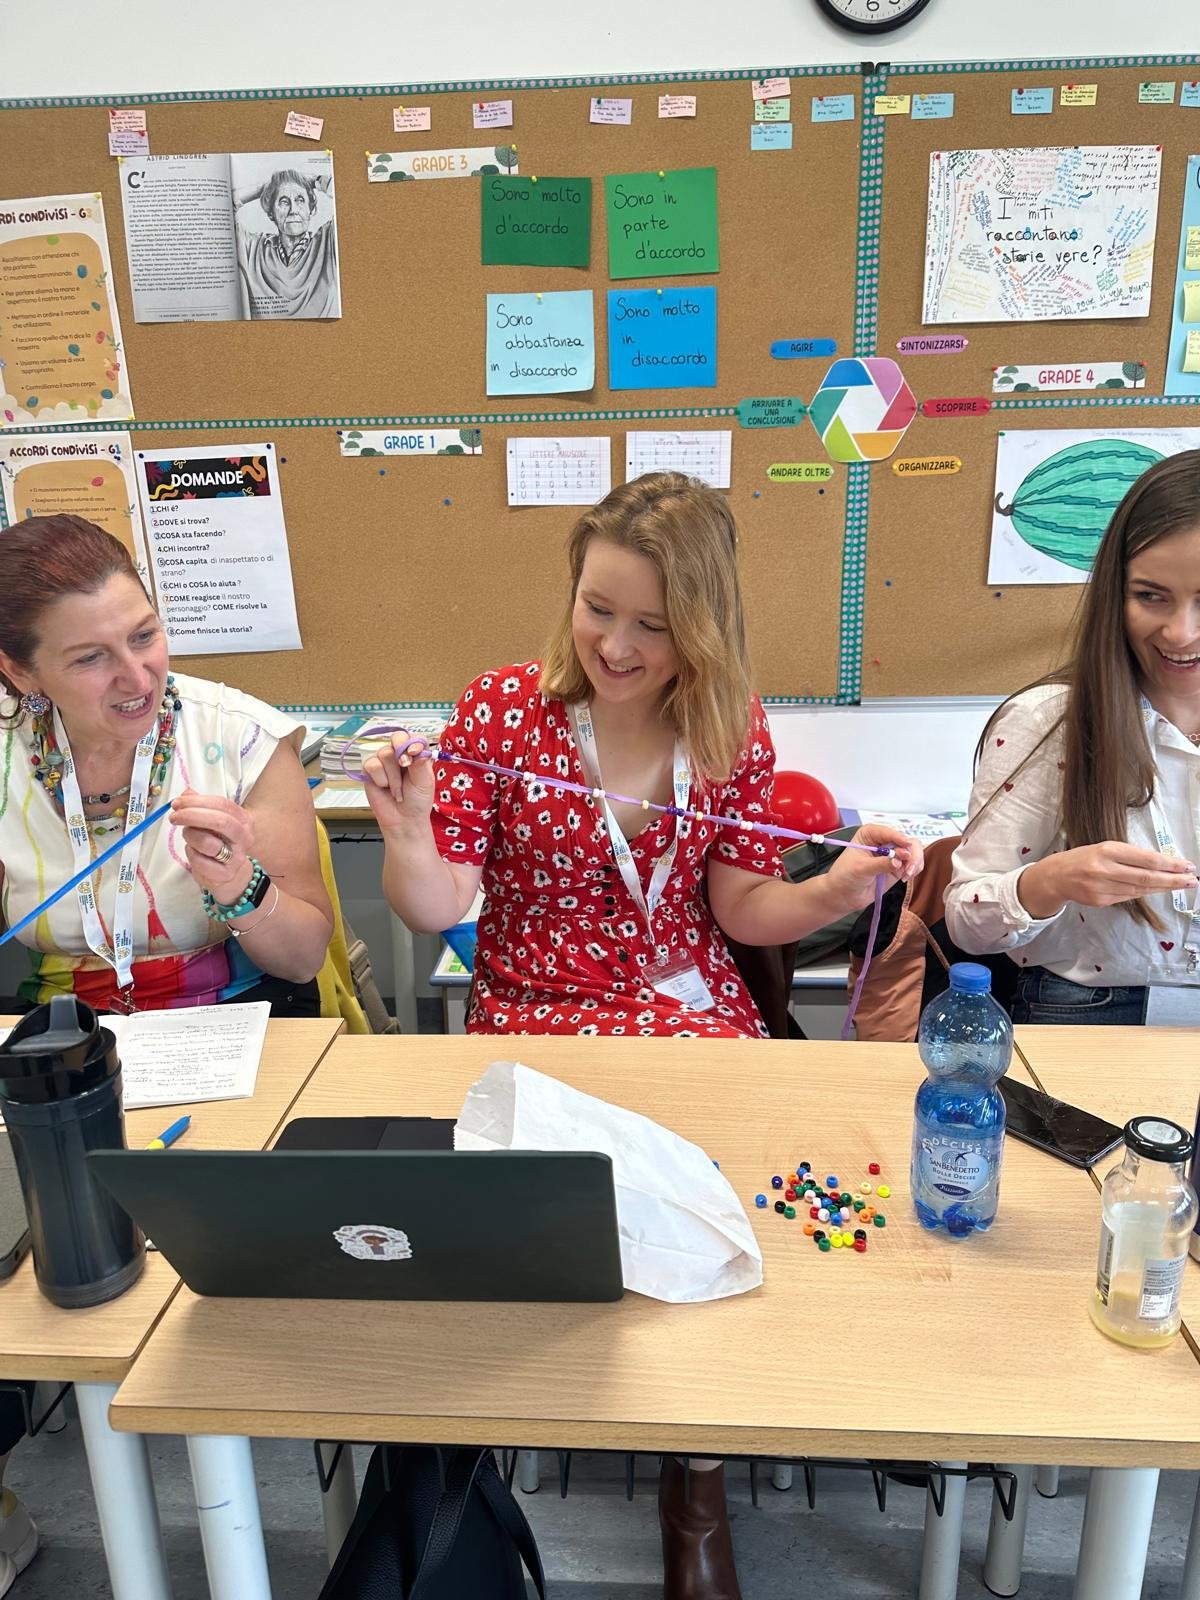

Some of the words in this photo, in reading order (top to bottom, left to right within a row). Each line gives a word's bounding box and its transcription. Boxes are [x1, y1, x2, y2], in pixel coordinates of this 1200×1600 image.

[412, 156, 455, 172] GRADE
[459, 155, 468, 170] 3
[128, 172, 146, 188] C'
[491, 180, 530, 202] Sono
[542, 186, 581, 204] molto
[614, 184, 654, 209] Sono
[663, 190, 677, 204] in
[997, 197, 1015, 219] I
[1028, 205, 1054, 220] miti
[496, 215, 569, 235] d'accordo
[622, 215, 669, 239] parte
[986, 225, 1078, 241] raccontano
[635, 241, 705, 259] d'accordo
[1056, 245, 1102, 265] vere?
[497, 304, 533, 328] Sono
[615, 297, 650, 321] Sono
[663, 300, 700, 317] molto
[505, 333, 584, 350] abbastanza
[622, 335, 635, 344] in
[900, 340, 964, 350] SINTONIZZARSI
[790, 343, 814, 352] AGIRE
[491, 362, 499, 371] in
[509, 361, 577, 378] disaccordo
[1038, 370, 1081, 384] GRADE
[1086, 370, 1094, 382] 4
[752, 400, 786, 408] ARRIVARE
[787, 400, 792, 408] A
[935, 402, 977, 413] SCOPRIRE
[764, 408, 779, 416] UNA
[748, 416, 796, 425] CONCLUSIONE
[108, 444, 121, 454] G1
[384, 436, 424, 449] GRADE
[430, 436, 435, 448] 1
[770, 468, 802, 477] ANDARE
[805, 467, 830, 476] OLTRE
[899, 461, 956, 471] ORGANIZZARE
[171, 471, 244, 487] DOMANDE
[521, 491, 526, 499] U
[536, 491, 541, 499] V
[186, 558, 207, 567] capita
[219, 556, 259, 565] inaspettato
[191, 594, 220, 602] reagisce
[167, 605, 211, 613] personaggio?
